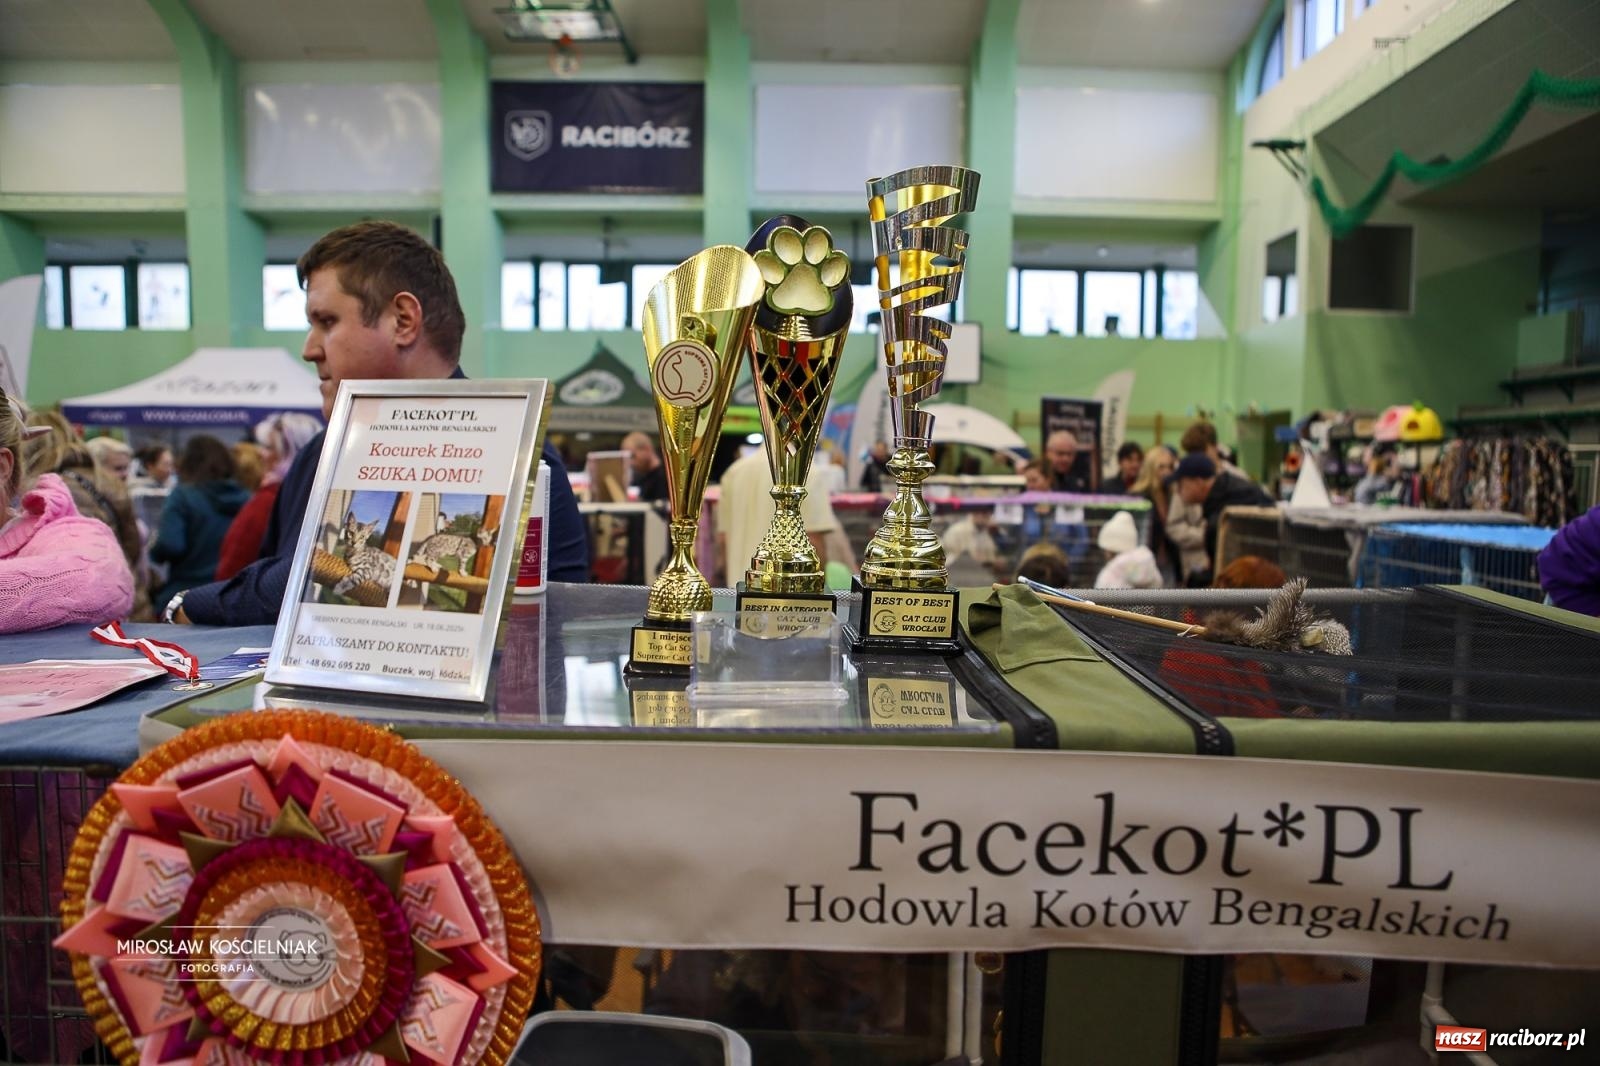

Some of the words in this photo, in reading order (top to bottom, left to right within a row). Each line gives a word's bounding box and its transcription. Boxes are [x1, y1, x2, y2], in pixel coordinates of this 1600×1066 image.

[561, 120, 691, 148] RACIBÓRZ
[369, 424, 409, 432] HODOWLA
[410, 424, 439, 432] KOTÓW
[441, 425, 497, 433] BENGALSKICH
[369, 442, 437, 458] Kocurek
[441, 444, 483, 460] Enzo
[358, 466, 417, 481] SZUKA
[422, 468, 483, 484] DOMU!
[873, 596, 903, 605] BEST
[905, 597, 921, 606] OF
[922, 598, 951, 607] BEST
[744, 604, 769, 612] BEST
[901, 614, 921, 623] CAT
[922, 615, 947, 624] CLUB
[296, 635, 376, 651] ZAPRASZAMY
[377, 640, 395, 652] DO
[396, 642, 470, 659] KONTAKTU!
[648, 643, 663, 652] Top
[637, 651, 671, 661] Supreme
[672, 653, 685, 661] Cat
[321, 659, 336, 668] 692
[338, 661, 353, 670] 695
[354, 662, 370, 671] 220
[785, 882, 1009, 929] Hodowla
[1029, 888, 1192, 929] Kotów
[1208, 886, 1512, 942] Bengalskich
